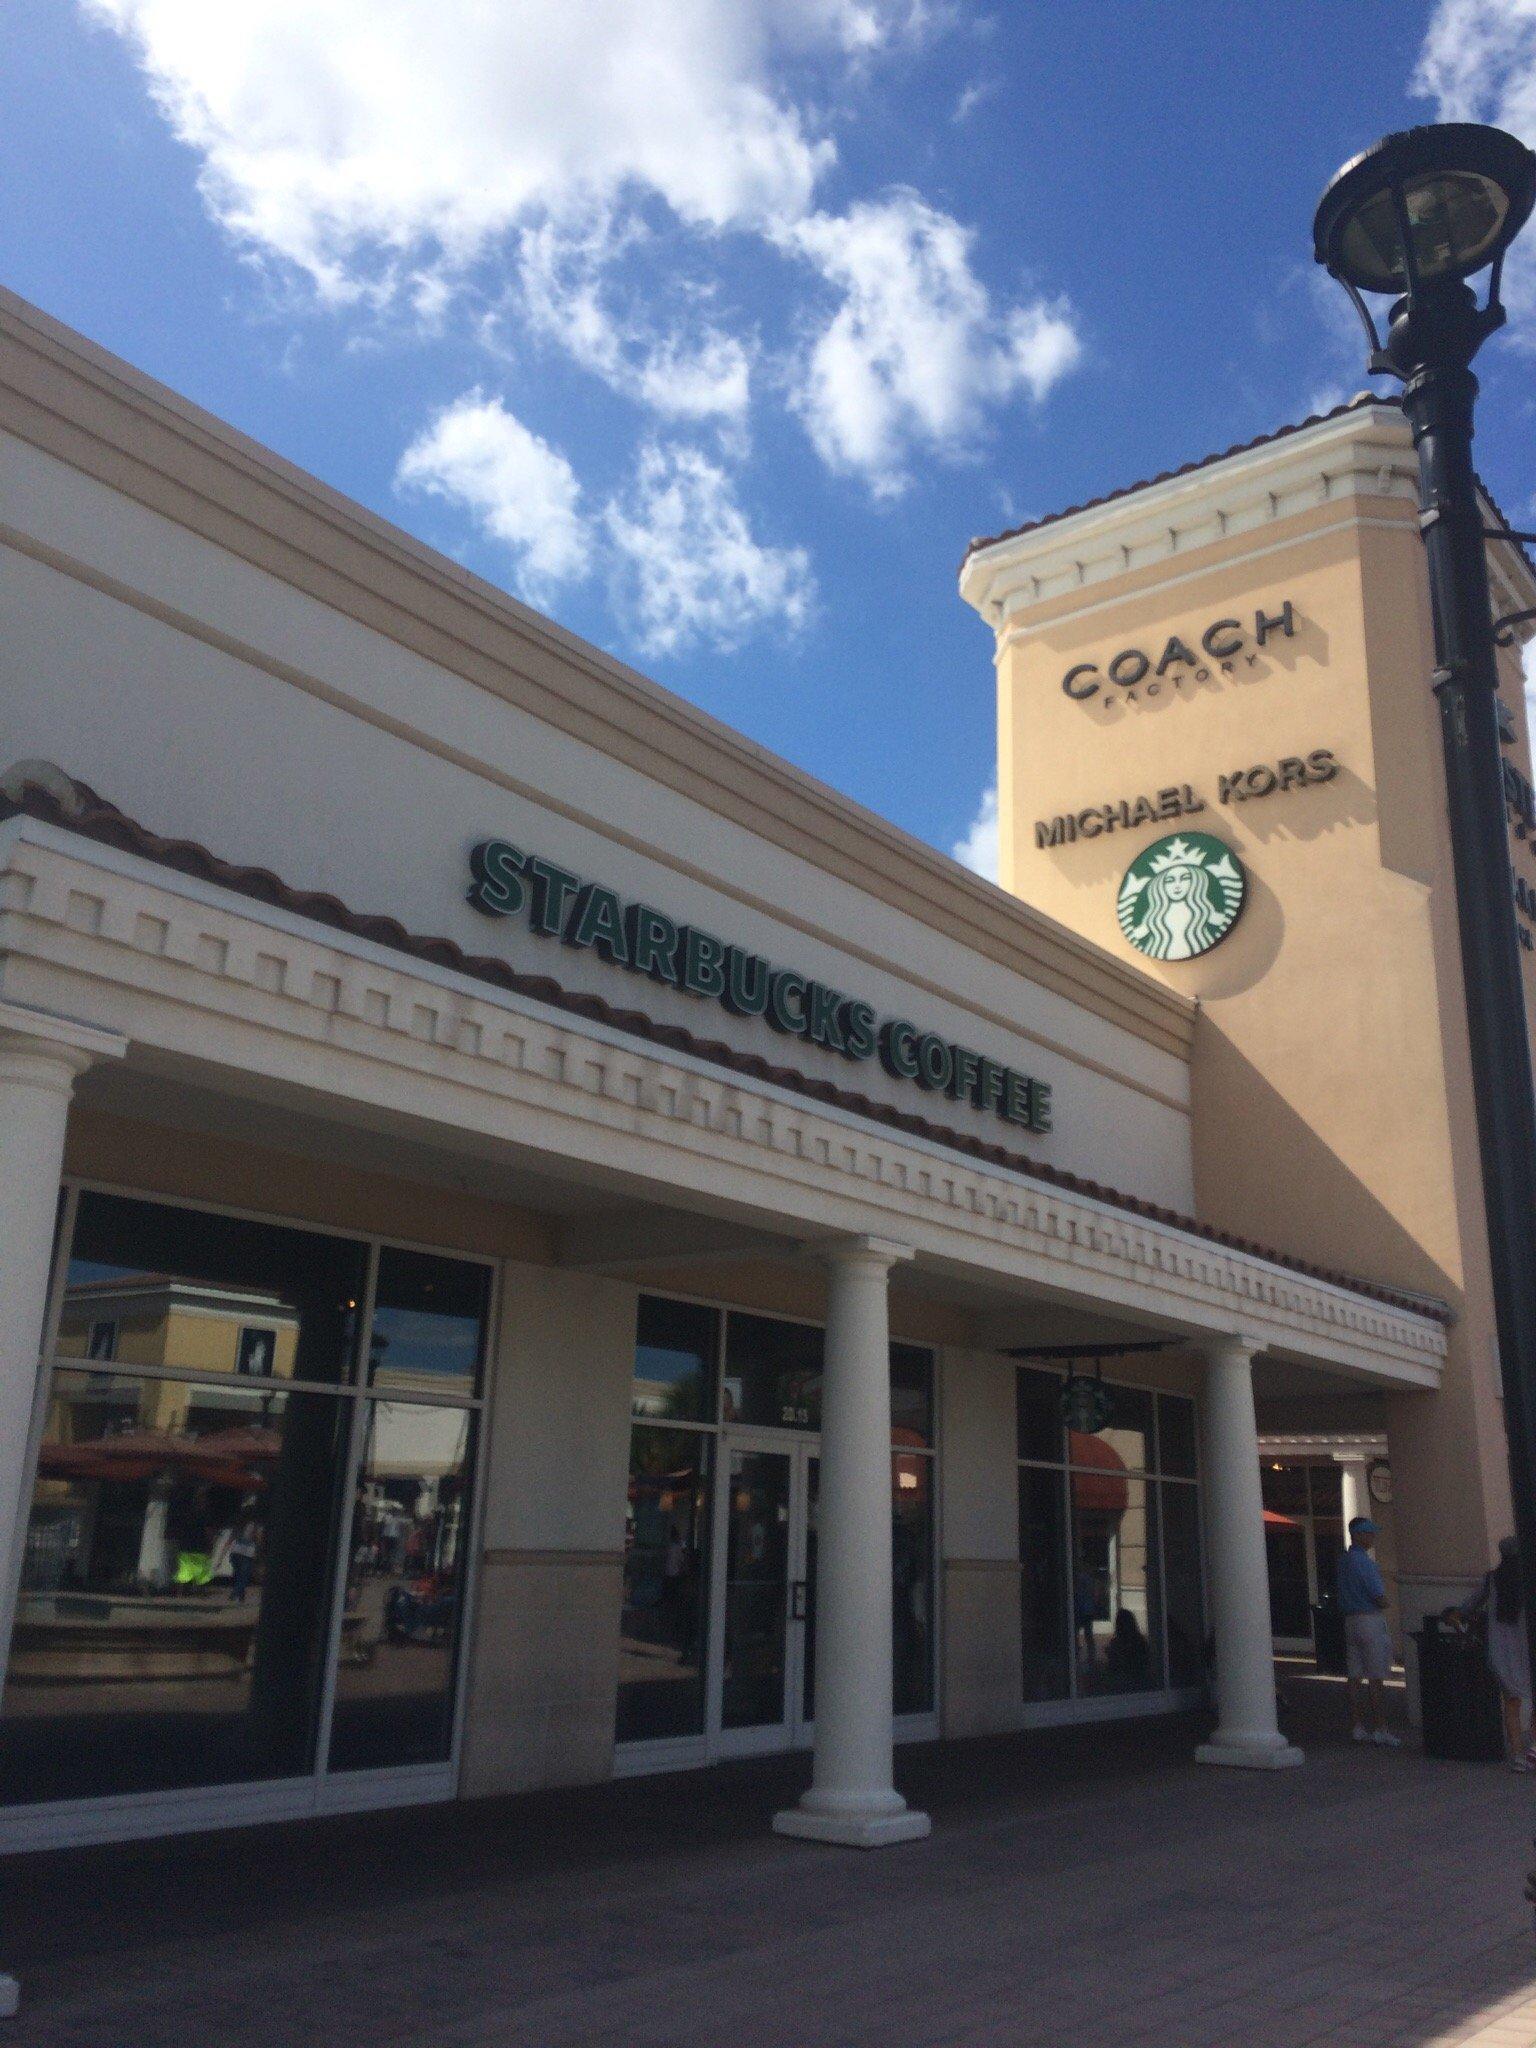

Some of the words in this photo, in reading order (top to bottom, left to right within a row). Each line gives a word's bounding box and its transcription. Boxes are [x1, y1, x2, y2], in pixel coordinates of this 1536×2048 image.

[1062, 600, 1295, 700] COACH
[1104, 653, 1257, 709] FACTORY
[1034, 784, 1205, 849] MICHAEL
[1217, 749, 1340, 805] KORS
[468, 839, 878, 1061] STARBUCKS
[879, 1019, 1055, 1134] COFFEE
